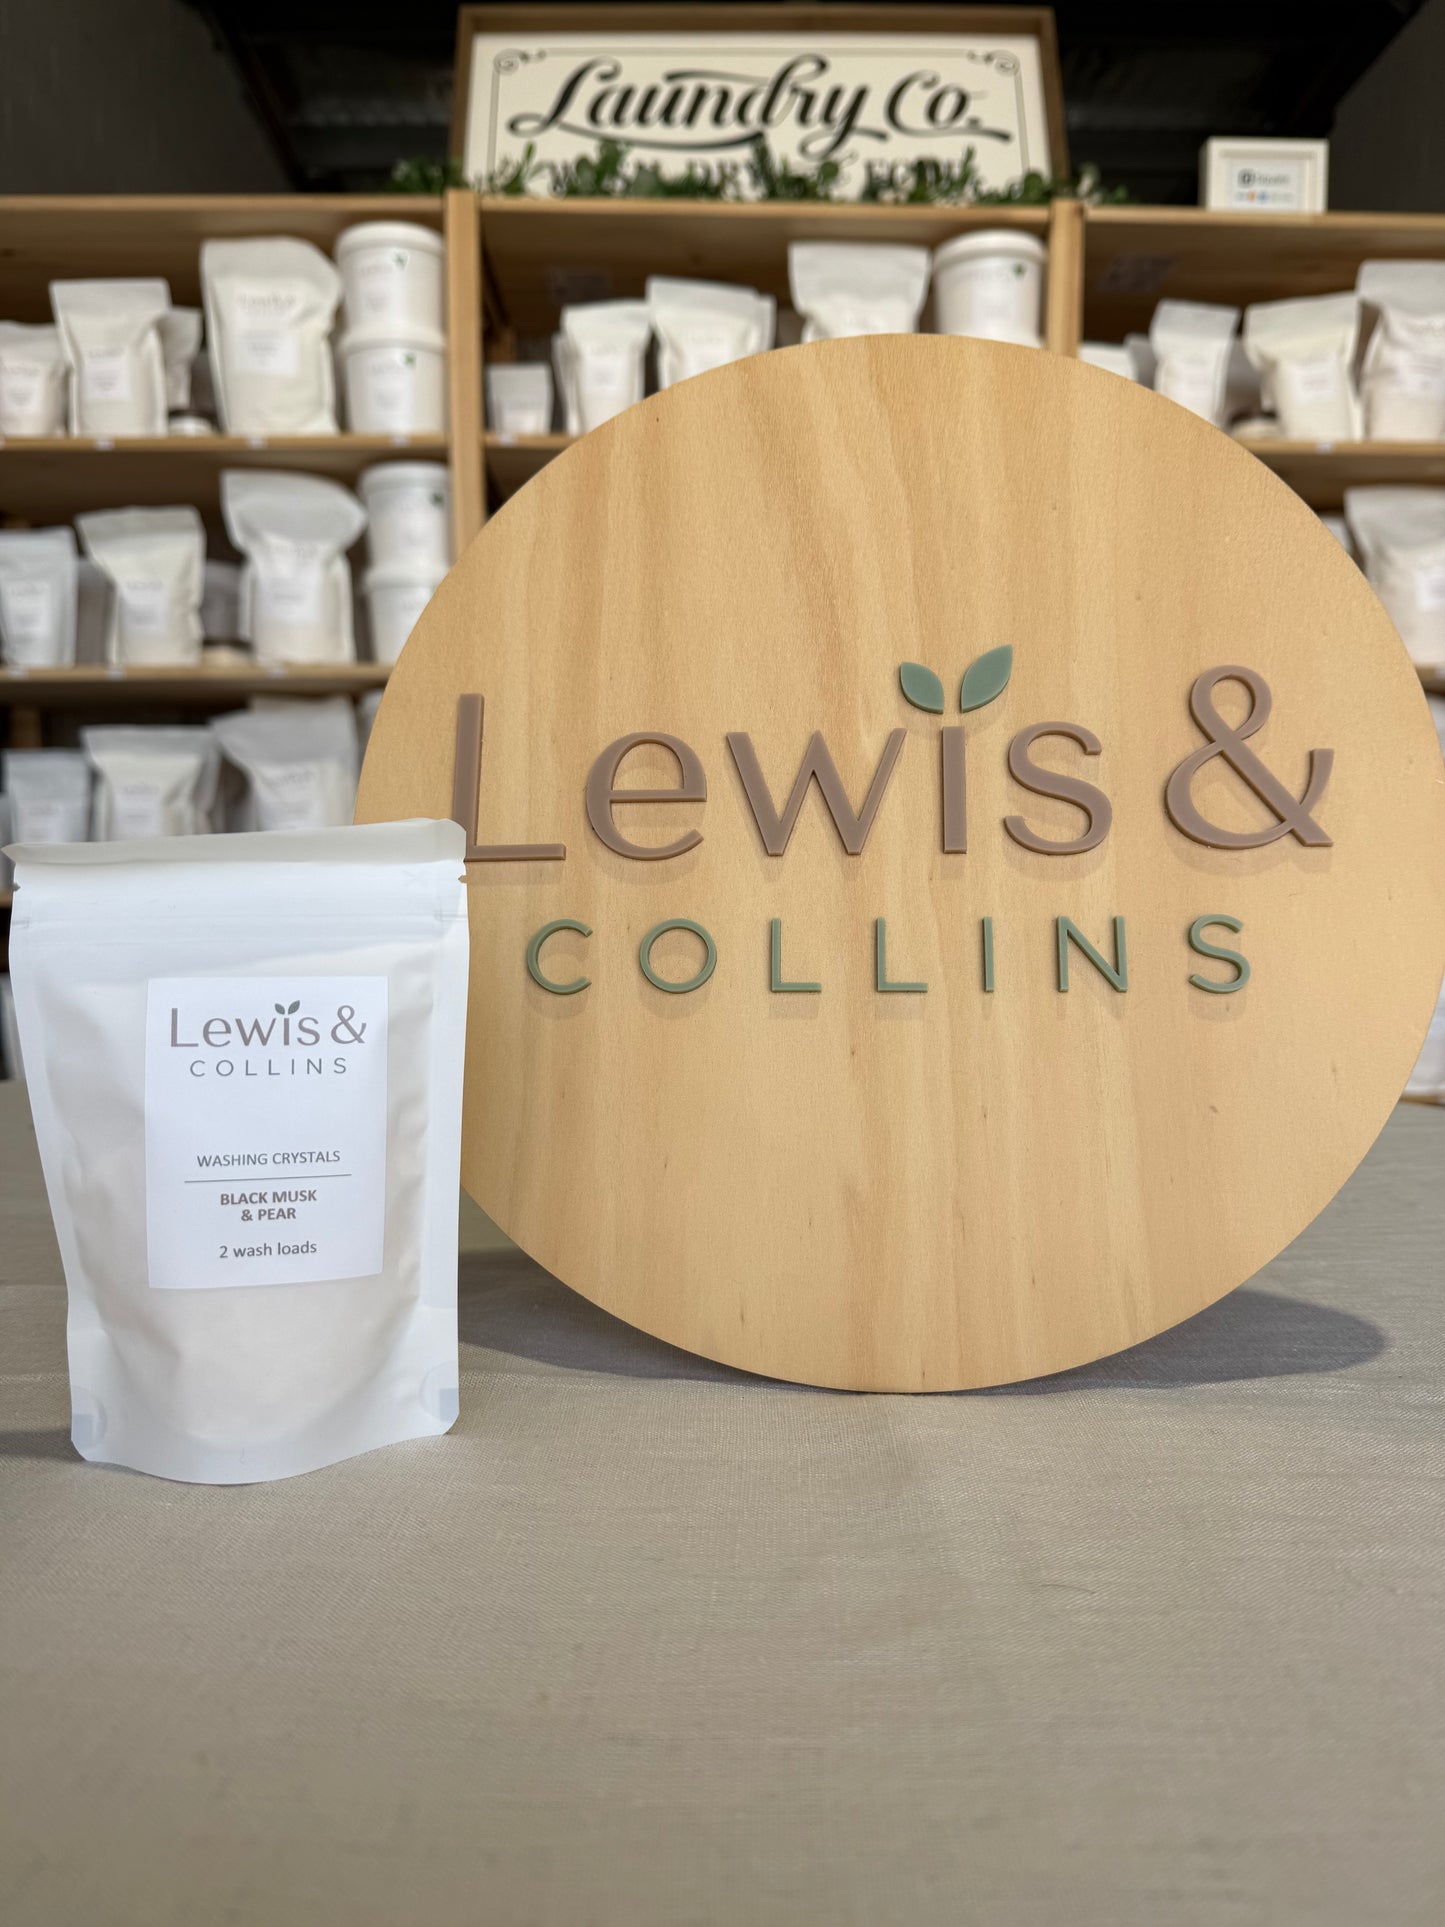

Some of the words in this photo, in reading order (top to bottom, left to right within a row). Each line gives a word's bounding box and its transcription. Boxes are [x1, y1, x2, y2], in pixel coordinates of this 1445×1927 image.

[507, 53, 888, 160] Laundry
[885, 70, 1012, 142] Co.
[451, 645, 1113, 862] Lewis
[1164, 665, 1334, 849] &
[526, 915, 1252, 994] COLLINS
[170, 1000, 320, 1047] Lewis
[331, 1005, 367, 1045] &
[189, 1057, 347, 1077] COLLINS
[197, 1153, 268, 1167] WASHING
[272, 1150, 341, 1165] CRYSTALS
[220, 1191, 268, 1206] BLACK
[272, 1189, 317, 1204] MUSK
[240, 1208, 253, 1222] &
[258, 1207, 297, 1222] PEAR
[219, 1245, 229, 1259] 2
[233, 1242, 273, 1259] wash
[277, 1240, 317, 1256] loads
